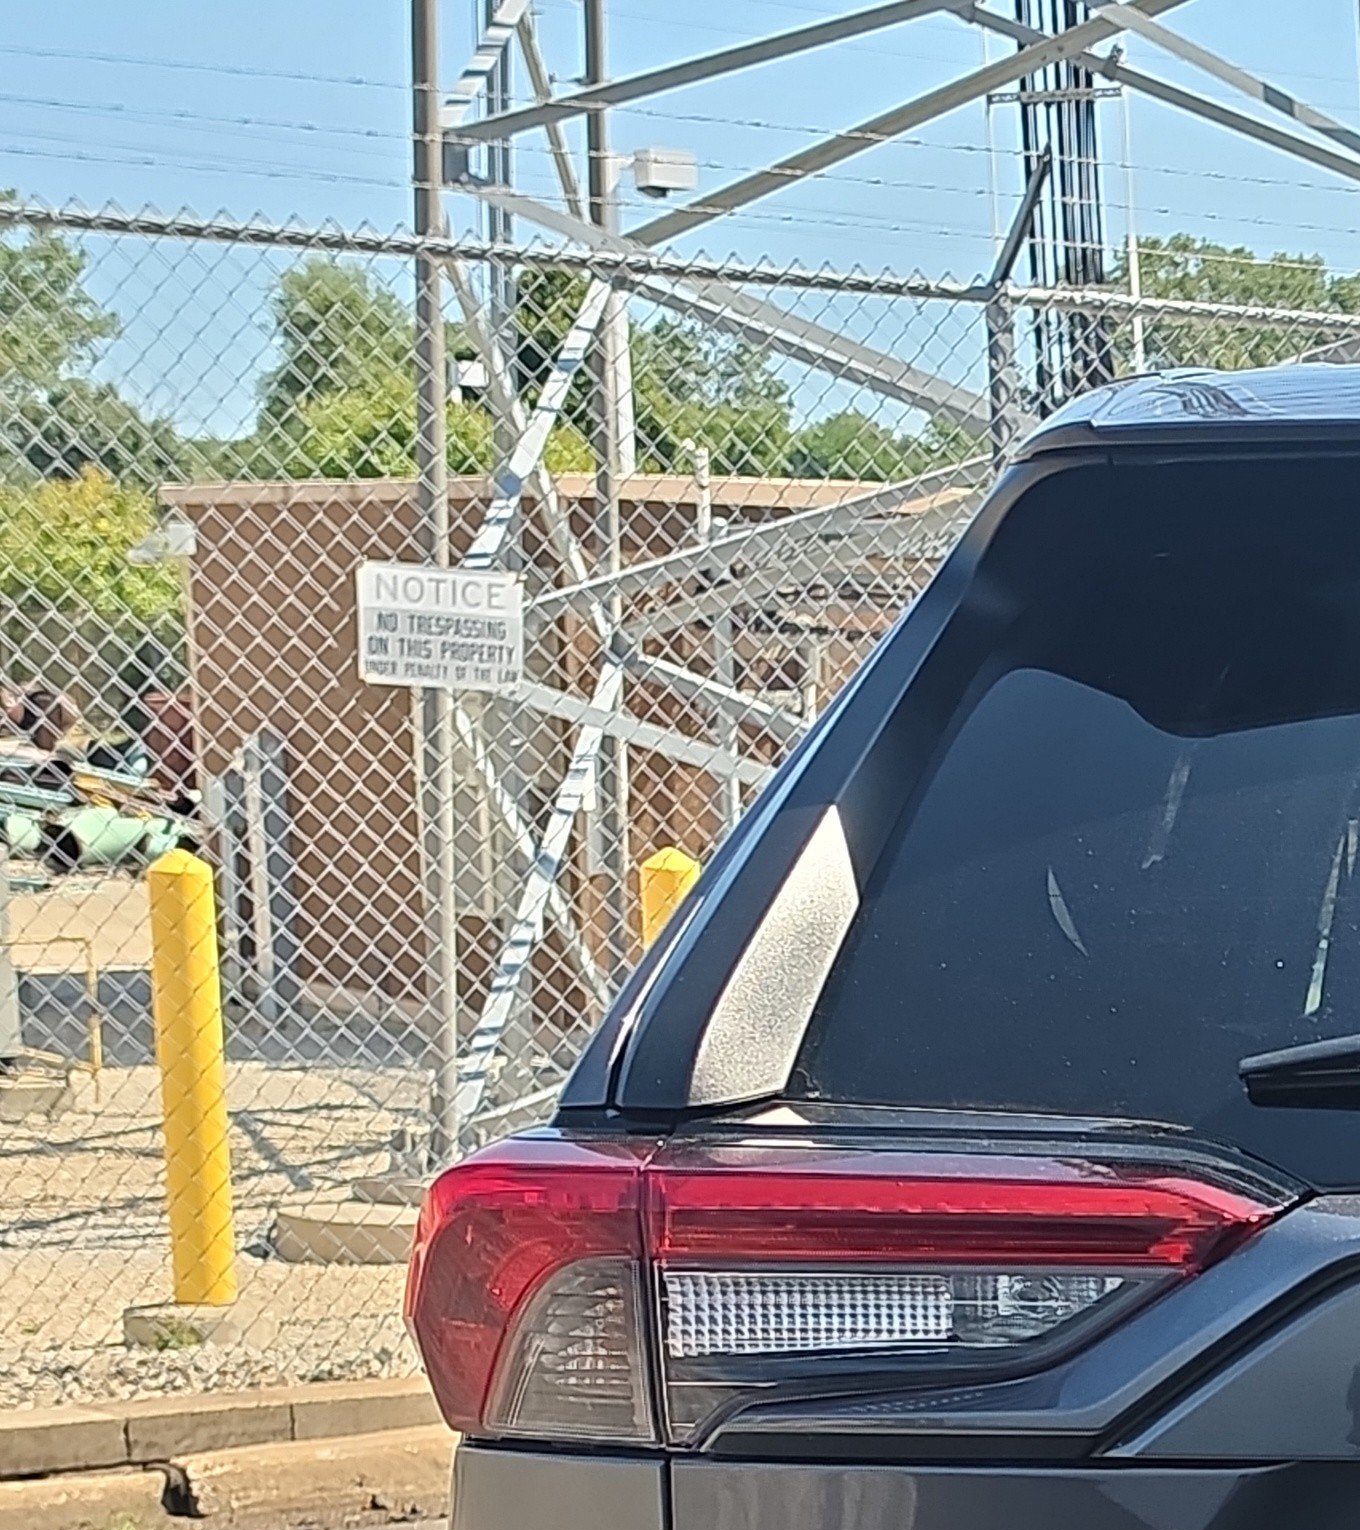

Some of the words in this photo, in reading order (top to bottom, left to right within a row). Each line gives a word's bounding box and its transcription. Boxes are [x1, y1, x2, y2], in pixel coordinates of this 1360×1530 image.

[374, 572, 507, 610] NOTICE
[376, 610, 399, 633] NO
[406, 614, 507, 642] TRESPASSING
[366, 635, 389, 655] ON
[398, 637, 433, 660] THIS
[439, 640, 515, 665] PROPERTY
